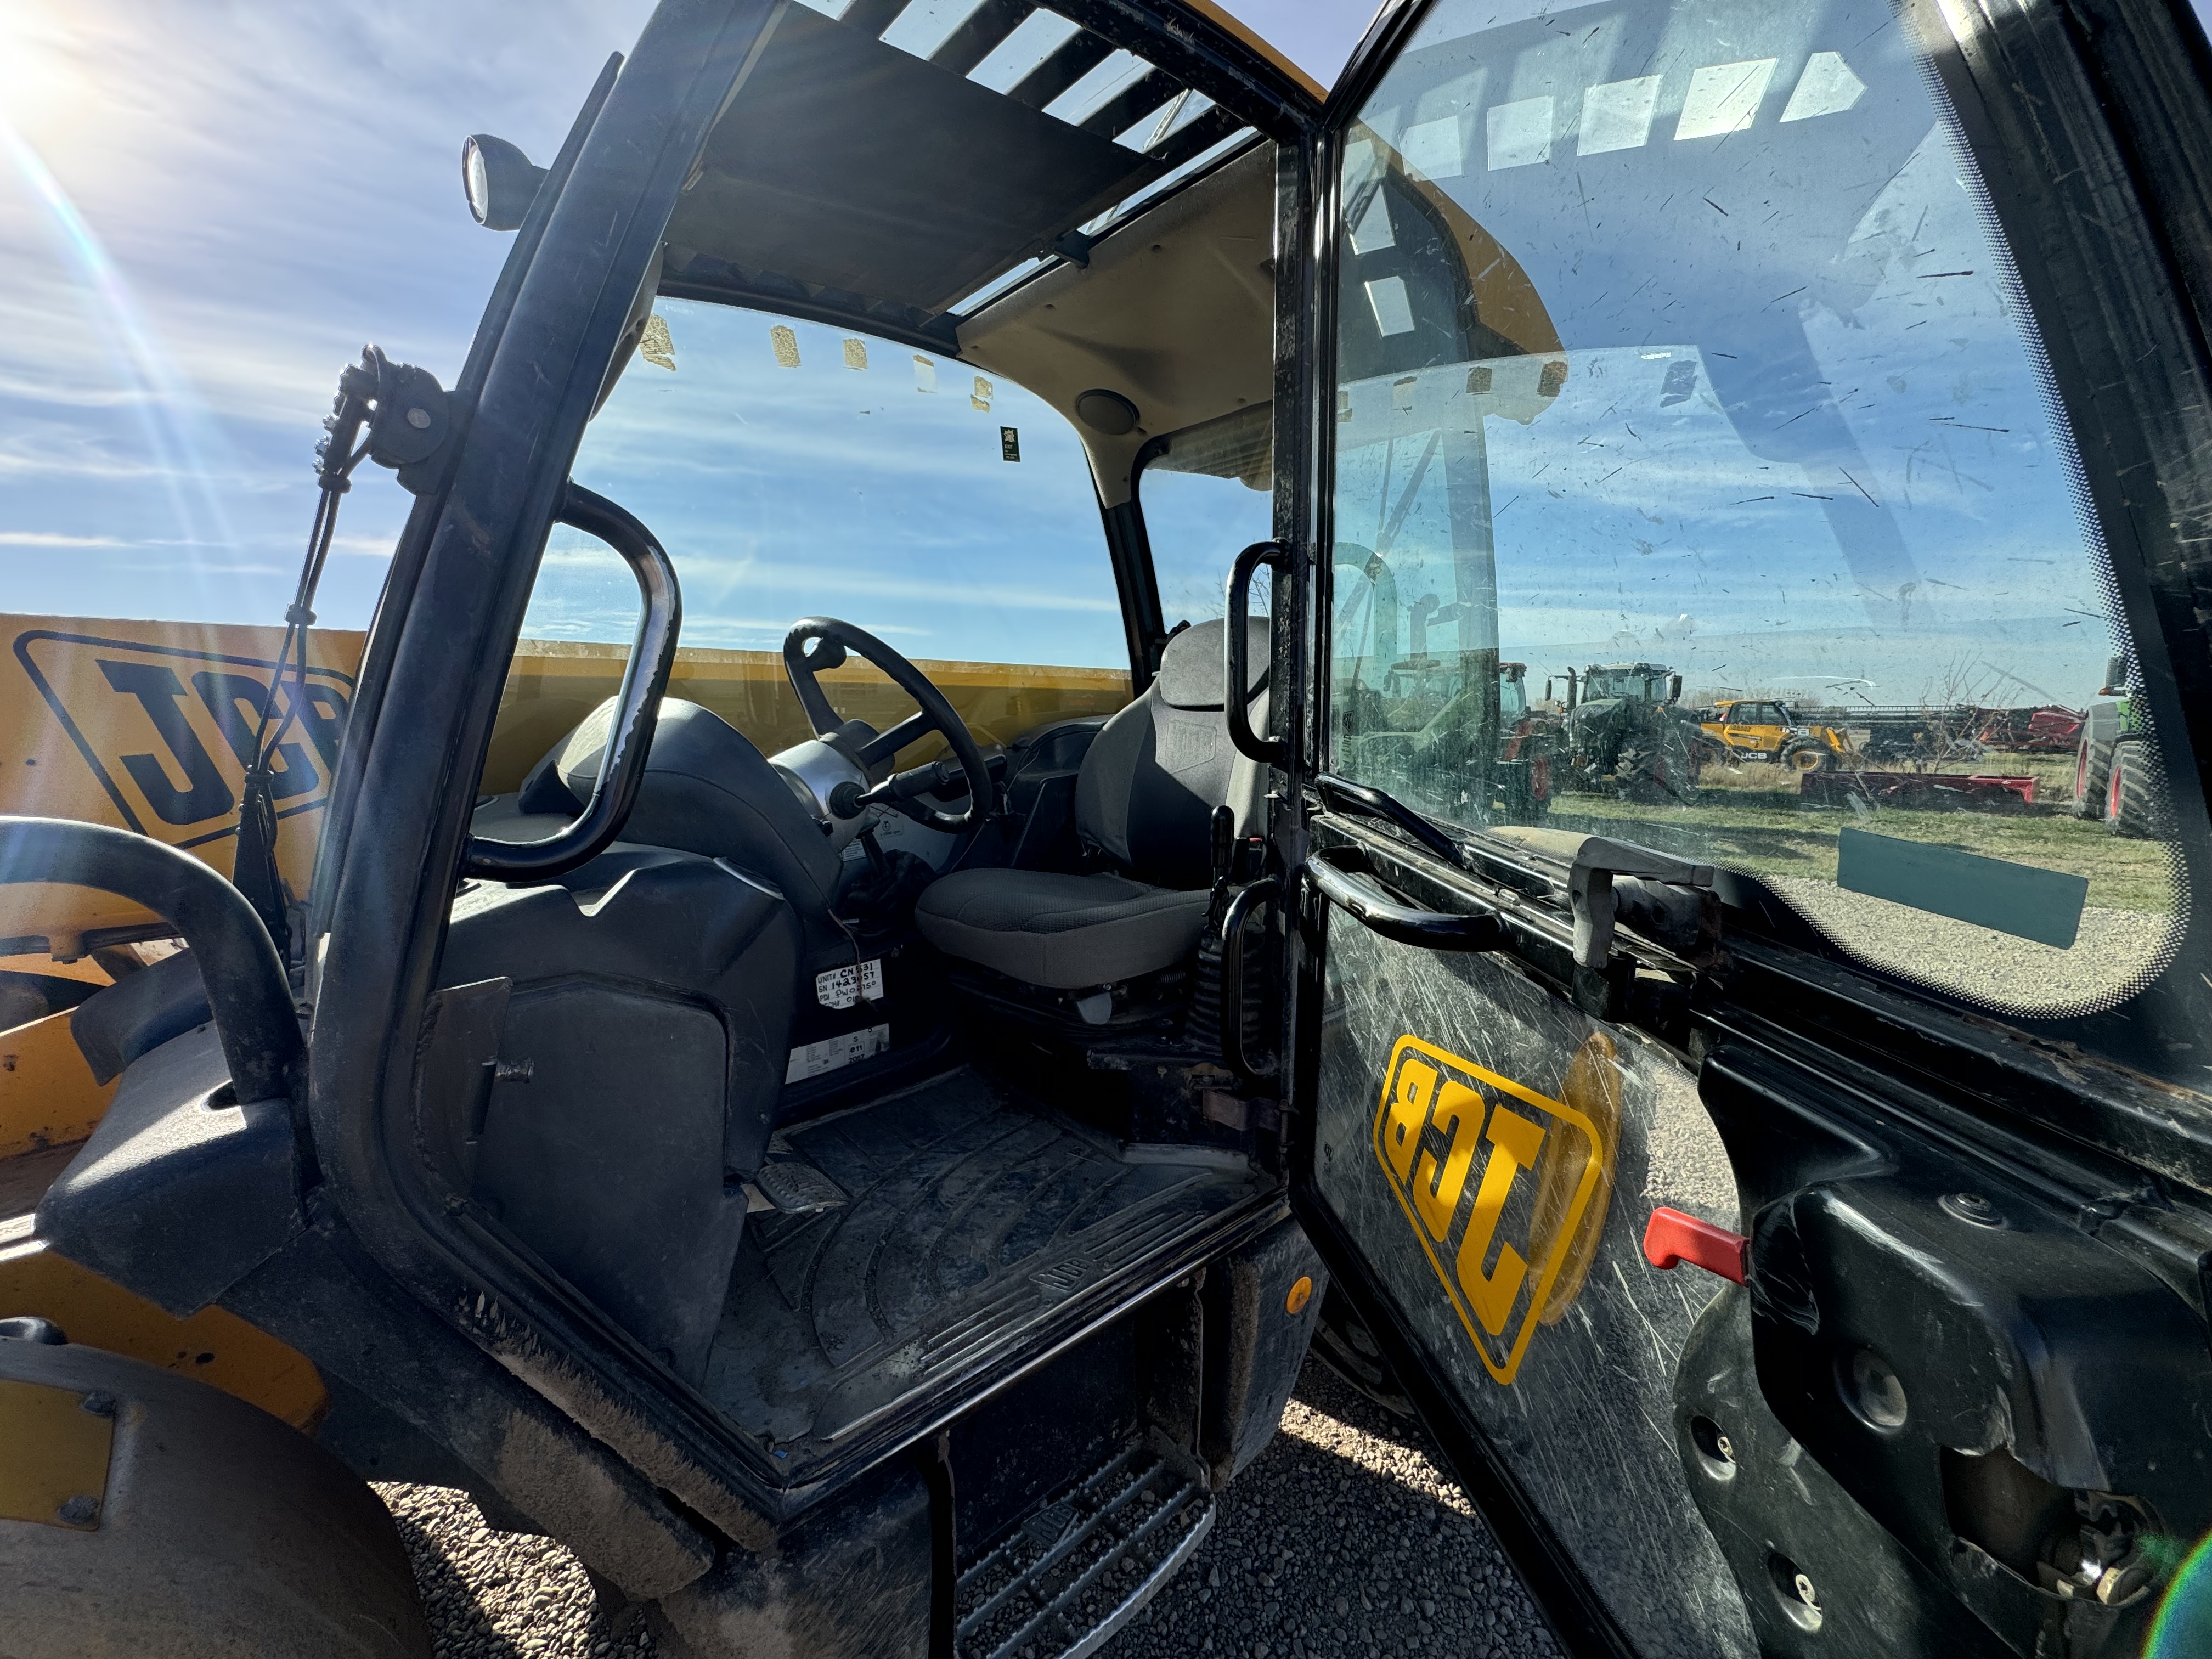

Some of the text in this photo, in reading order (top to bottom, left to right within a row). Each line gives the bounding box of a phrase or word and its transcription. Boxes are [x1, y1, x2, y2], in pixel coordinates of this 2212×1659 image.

[817, 973, 836, 984] UNIT#
[819, 985, 827, 993] SN
[820, 994, 830, 1002] PDI
[1039, 1260, 1088, 1289] JCB
